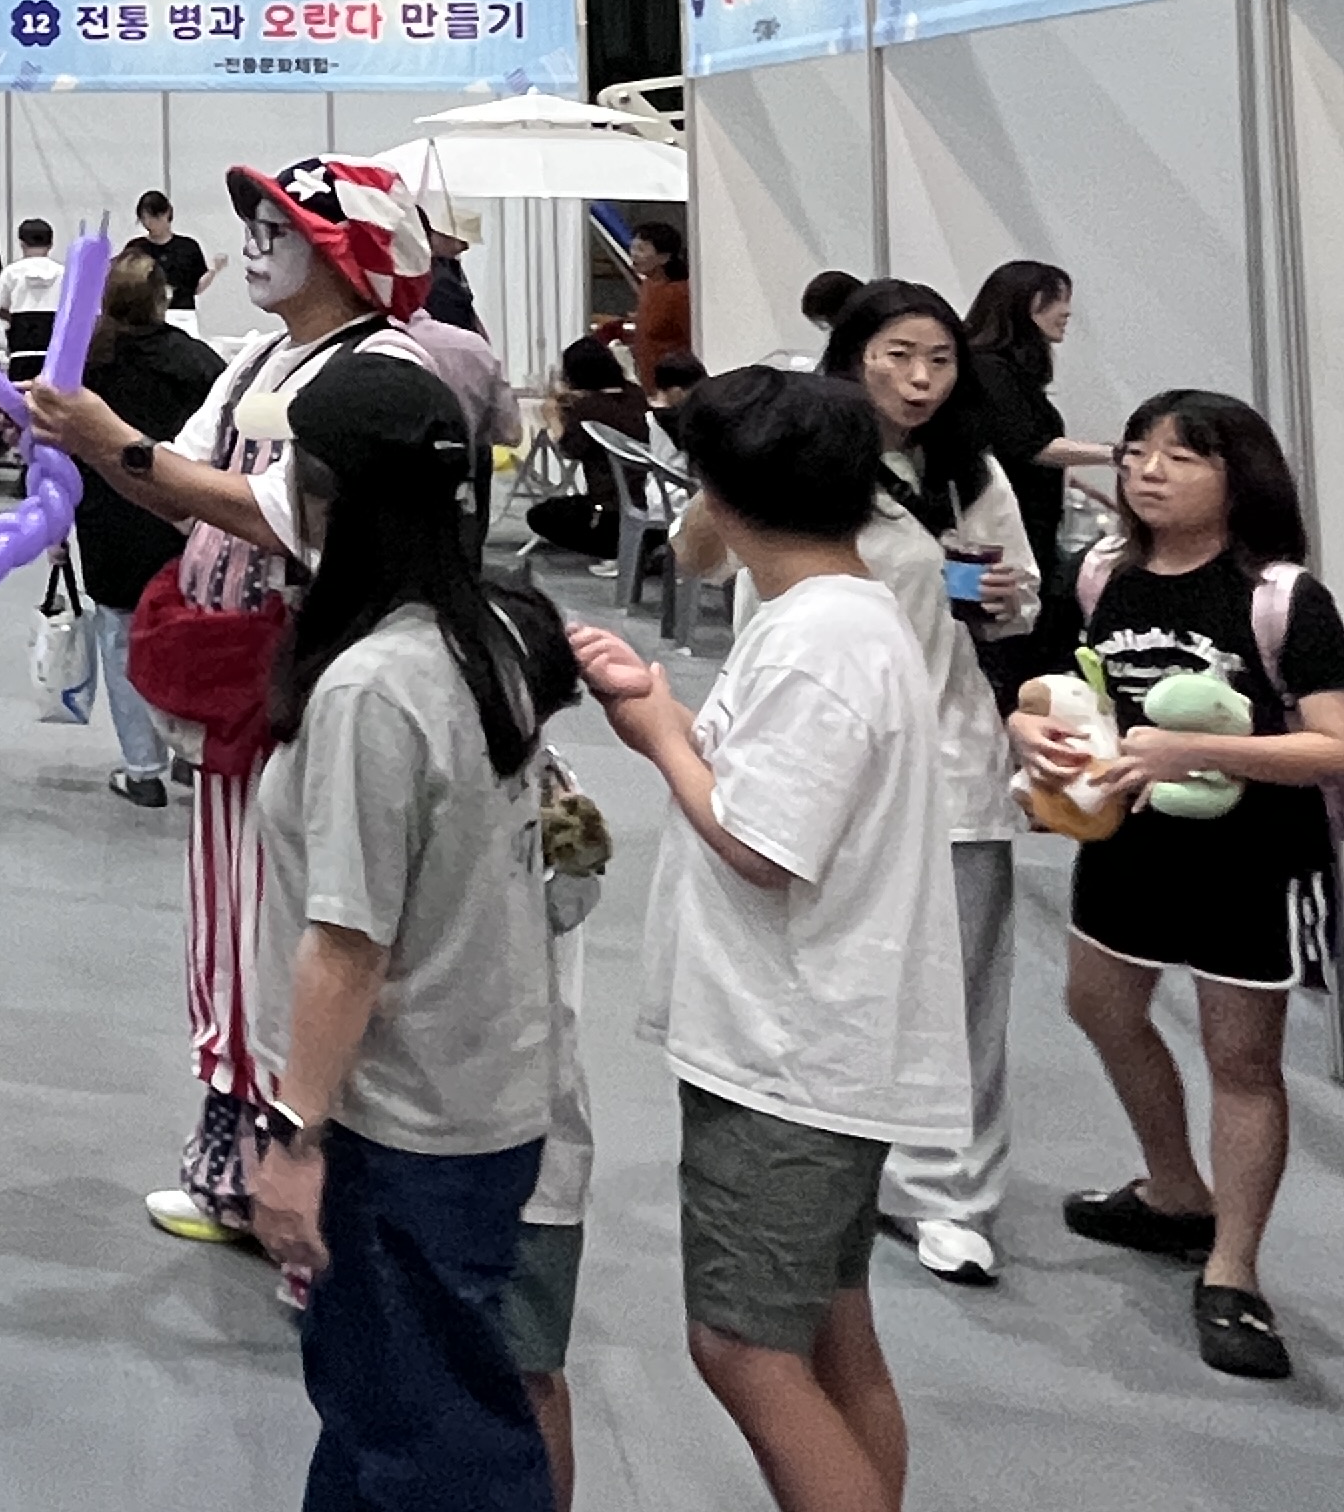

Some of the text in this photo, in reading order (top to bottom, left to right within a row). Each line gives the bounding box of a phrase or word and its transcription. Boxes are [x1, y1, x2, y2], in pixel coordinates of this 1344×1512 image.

[22, 13, 51, 34] 12
[76, 1, 524, 40] 전통 병과 오란다 만들기
